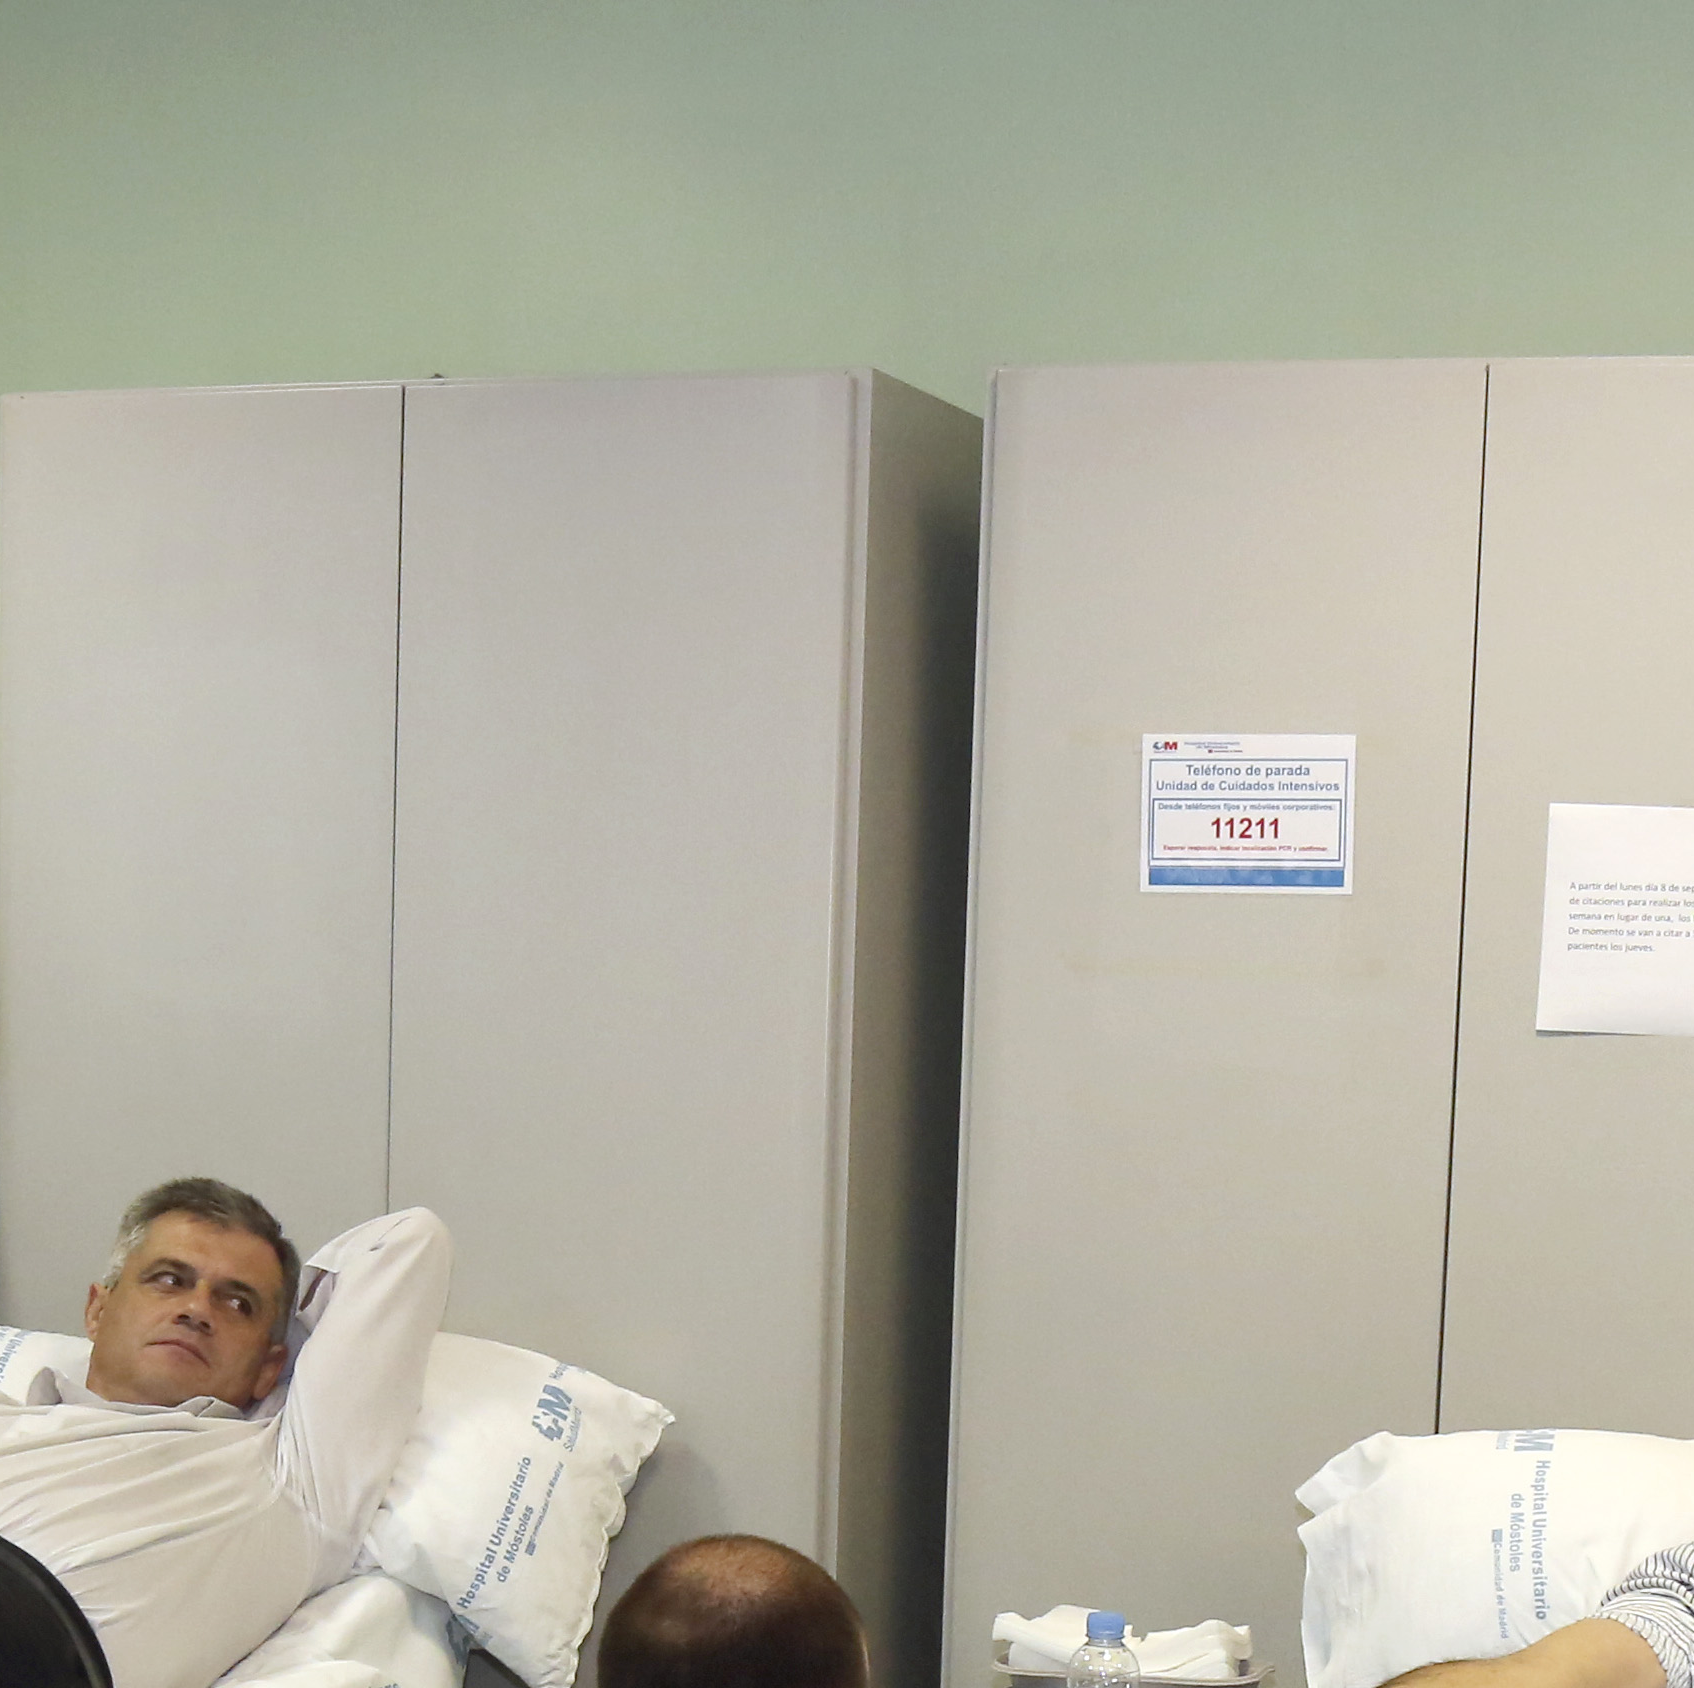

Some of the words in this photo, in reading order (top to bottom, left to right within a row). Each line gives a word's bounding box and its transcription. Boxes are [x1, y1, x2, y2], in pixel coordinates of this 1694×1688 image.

[1186, 764, 1241, 776] Teléfono
[1246, 765, 1261, 776] de
[1265, 765, 1310, 778] parada
[1156, 780, 1197, 791] Unidad
[1201, 781, 1215, 791] de
[1219, 781, 1274, 791] Cuidados
[1278, 781, 1340, 791] Intensivos
[1158, 802, 1182, 811] Desde
[1185, 802, 1221, 811] teléfonos
[1224, 803, 1240, 812] fijos
[1250, 803, 1280, 811] móviles
[1211, 817, 1279, 839] 11211
[1570, 882, 1576, 890] A
[1578, 883, 1602, 893] partir
[1604, 883, 1617, 891] del
[1620, 883, 1643, 892] lunes
[1661, 883, 1666, 892] 8
[1668, 884, 1679, 892] de
[1570, 897, 1580, 905] de
[1582, 897, 1625, 907] citaciones
[1627, 900, 1647, 908] para
[1649, 899, 1681, 908] realizar
[1569, 914, 1602, 922] semana
[1604, 914, 1615, 922] en
[1617, 913, 1639, 923] lugar
[1641, 914, 1652, 922] de
[1679, 914, 1691, 923] los
[1568, 927, 1580, 935] De
[1582, 928, 1624, 936] momento
[1663, 928, 1683, 938] citar
[1567, 942, 1608, 952] pacientes
[1611, 942, 1623, 951] los
[1531, 1460, 1551, 1515] Hospital
[1511, 1493, 1525, 1508] de
[456, 1546, 498, 1610] Hospital
[489, 1456, 532, 1546] Universitario
[503, 1504, 534, 1564] Móstoles
[1509, 1512, 1525, 1572] Móstoles
[496, 1564, 511, 1583] de
[1494, 1543, 1504, 1592] Comunidad
[1532, 1518, 1550, 1620] Universitario
[1496, 1594, 1504, 1606] de
[1498, 1608, 1509, 1639] Madrid
